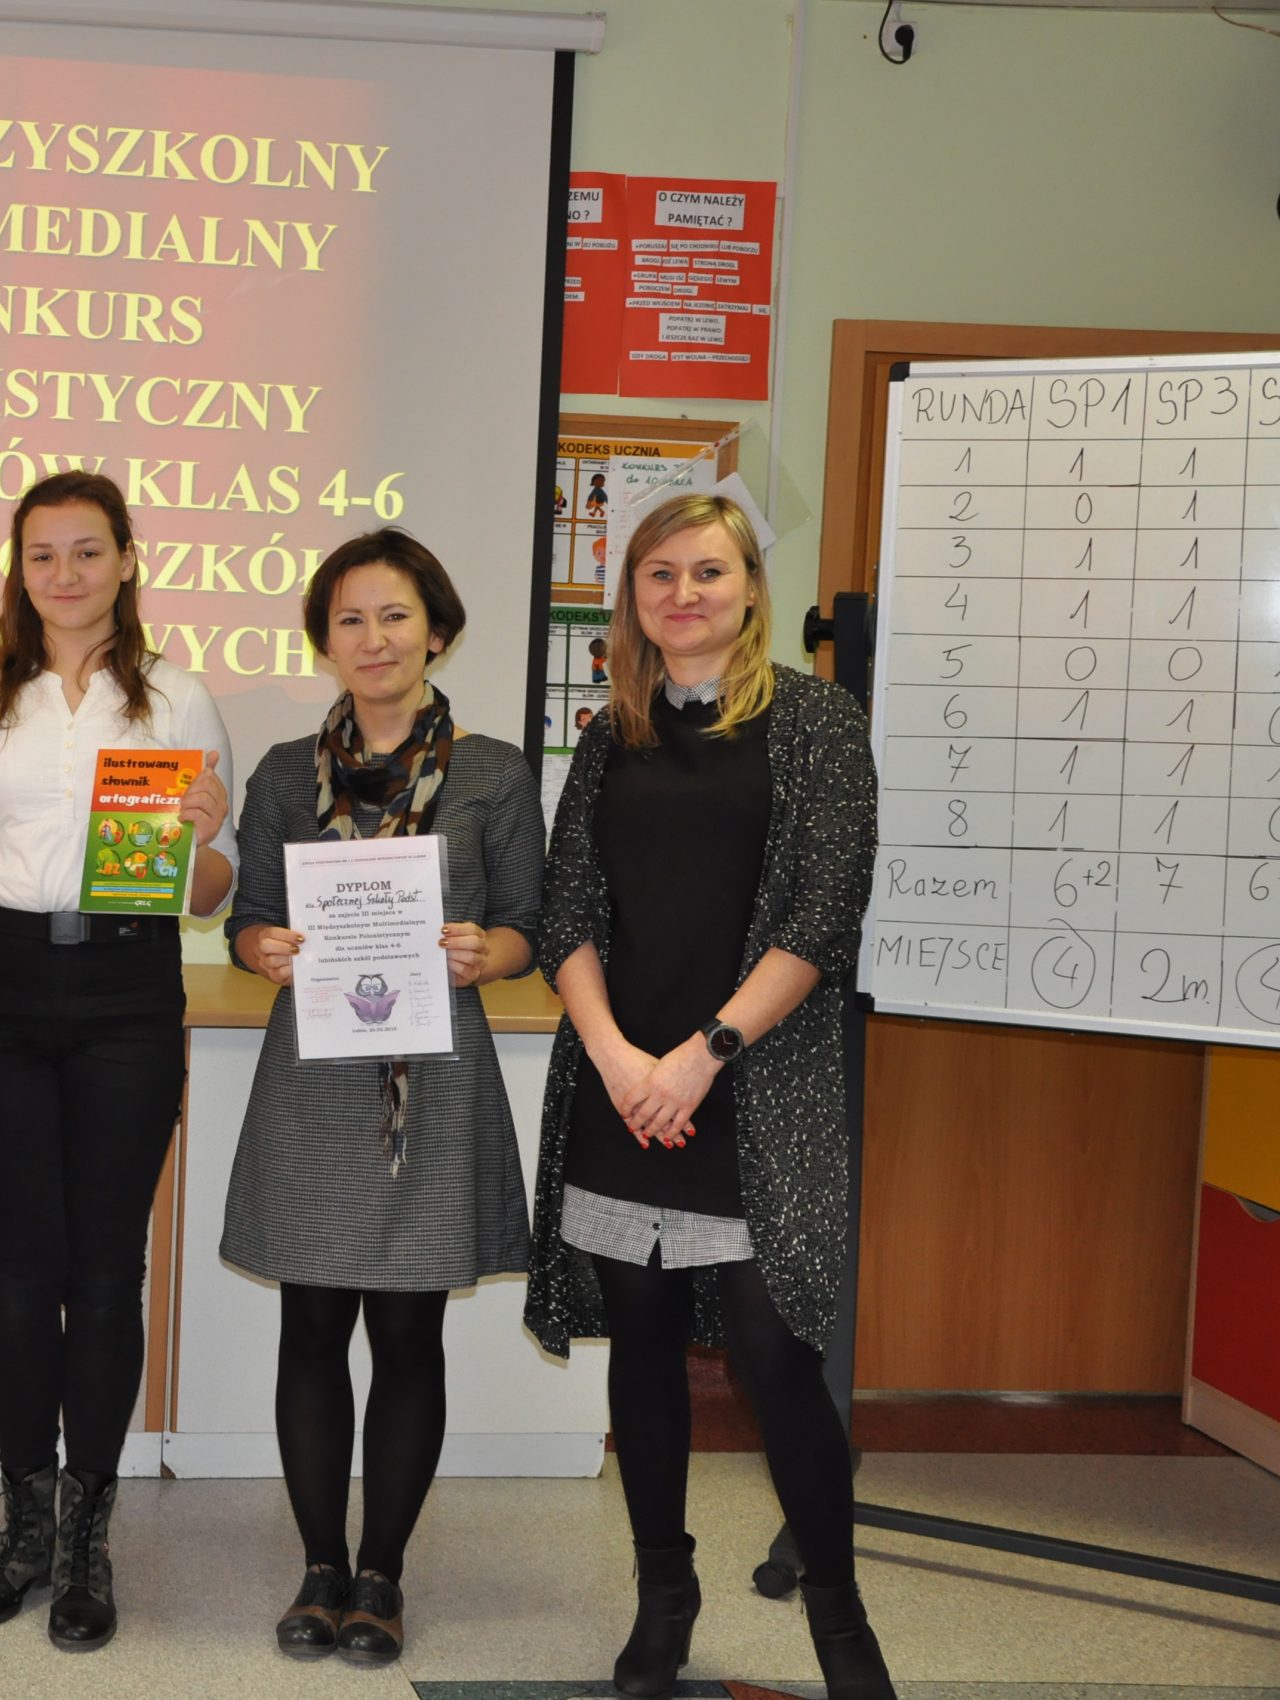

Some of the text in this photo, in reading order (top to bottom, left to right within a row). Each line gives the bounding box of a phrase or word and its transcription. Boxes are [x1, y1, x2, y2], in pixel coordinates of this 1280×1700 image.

[658, 192, 745, 207] O CZYM NALEŻY
[667, 213, 734, 227] PAMIĘTAĆ ?
[912, 387, 1027, 425] RUNDA
[1046, 377, 1132, 429] SP1
[558, 442, 661, 458] KODEKS UCZNIA
[954, 446, 1197, 482] 1 1 1
[124, 457, 301, 514] KLAS
[318, 468, 406, 520] 4-6
[948, 489, 1198, 525] 2 0 1
[948, 535, 1199, 572] 3 1 1
[943, 582, 1197, 630] 4 1 1
[939, 643, 973, 680] 5
[942, 689, 1194, 733] 6 1 1
[102, 775, 150, 787] słownik
[104, 758, 179, 772] ilustrowany
[948, 743, 1195, 787] 7 1 1
[99, 793, 181, 807] ortograficz
[947, 798, 1179, 845] 8 1 1
[336, 880, 392, 893] DYPLOM
[887, 858, 999, 900] Razem
[1155, 856, 1183, 905] 7
[876, 935, 1007, 987] MIEJSCE
[1051, 945, 1080, 989] 4
